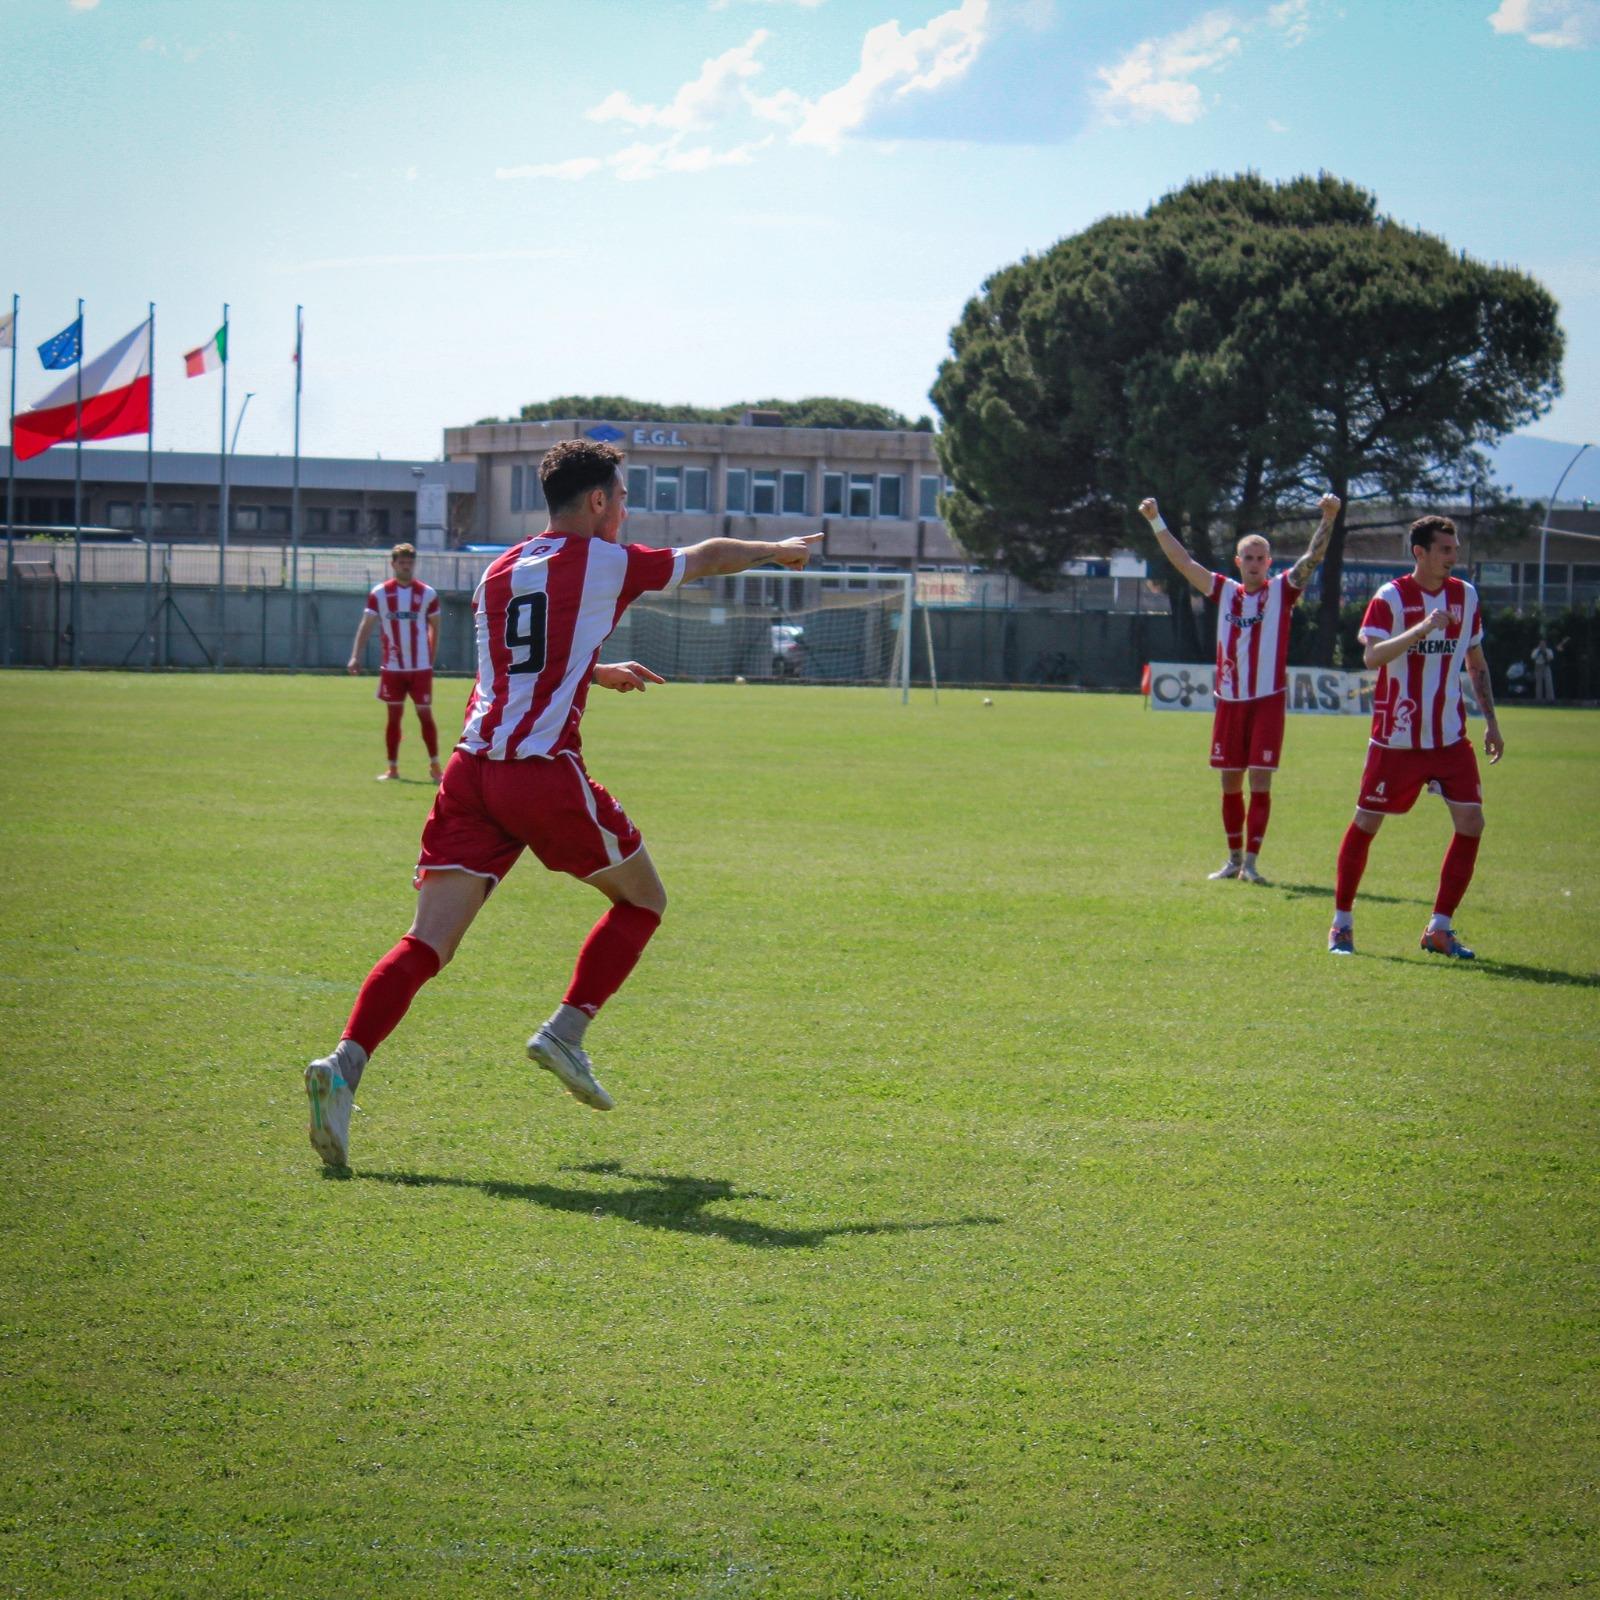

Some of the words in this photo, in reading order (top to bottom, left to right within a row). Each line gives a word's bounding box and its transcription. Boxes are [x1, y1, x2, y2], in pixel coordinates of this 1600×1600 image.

[633, 429, 687, 446] E.G.L.
[505, 591, 548, 676] 9
[1375, 781, 1386, 796] 4
